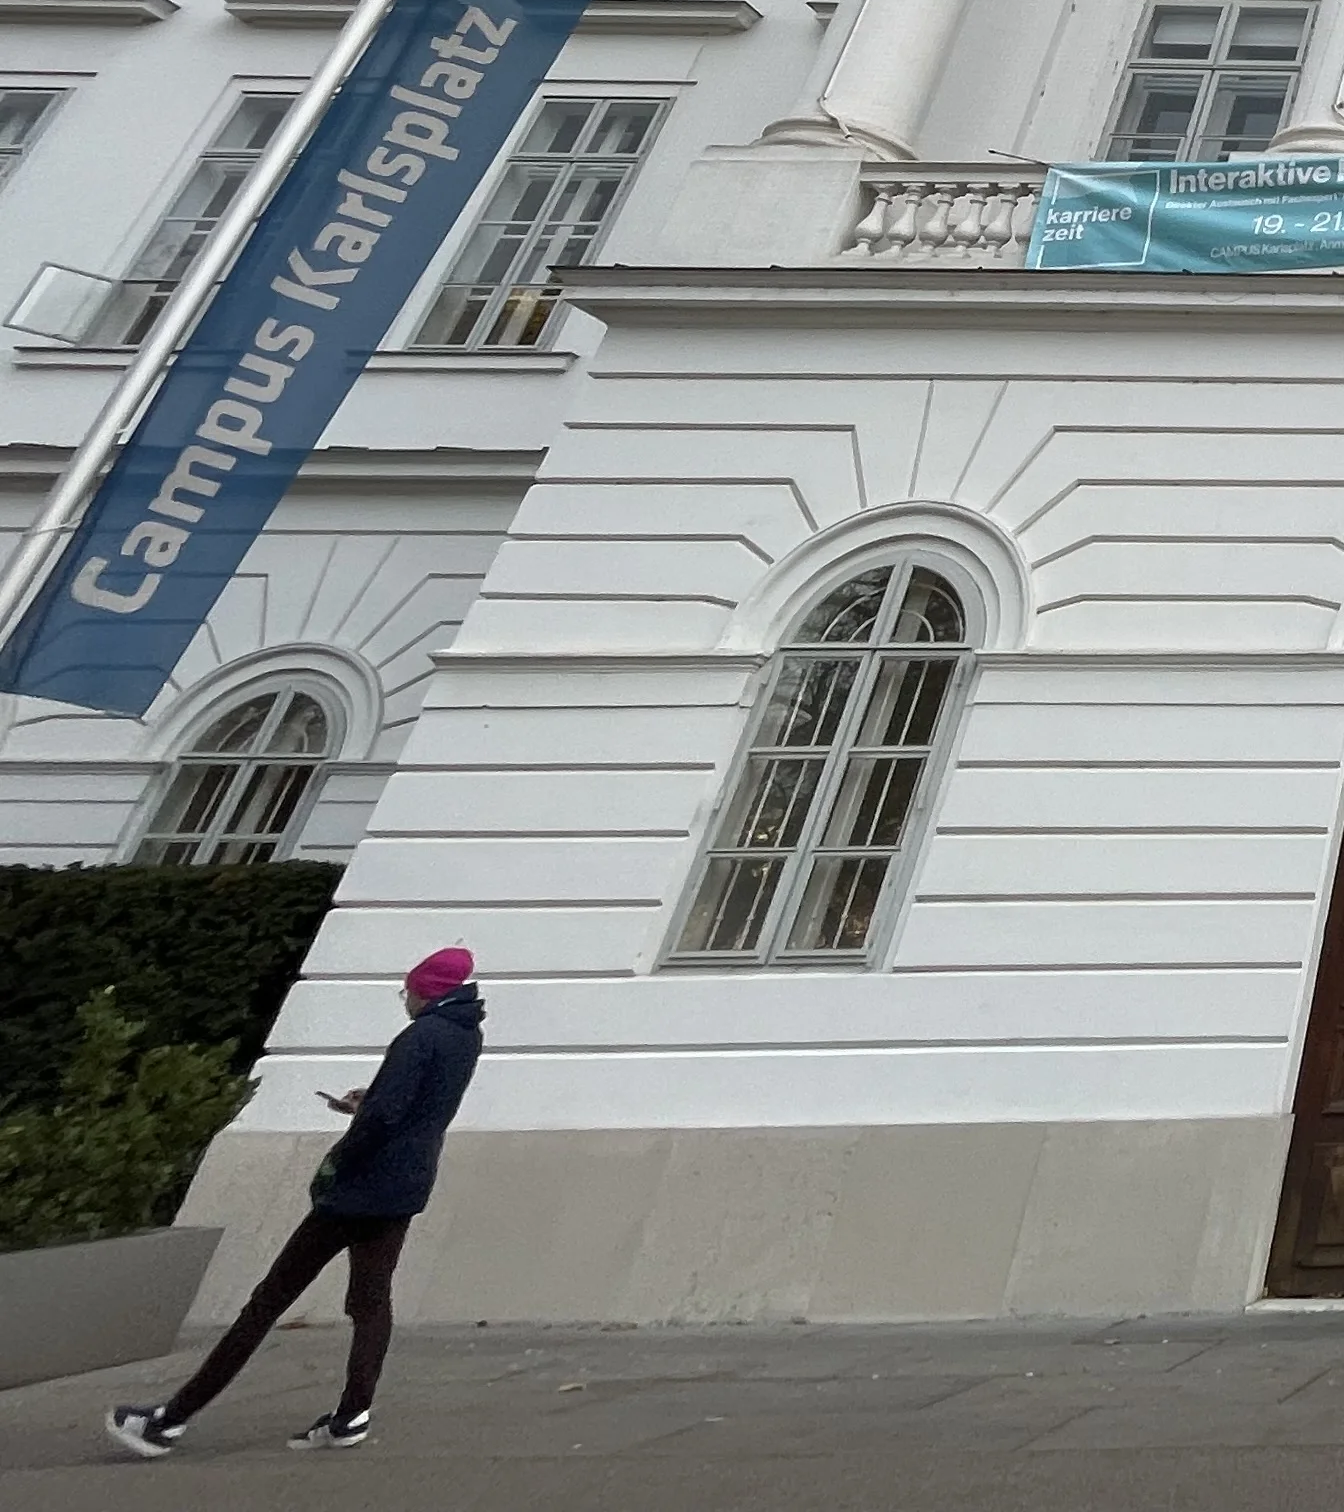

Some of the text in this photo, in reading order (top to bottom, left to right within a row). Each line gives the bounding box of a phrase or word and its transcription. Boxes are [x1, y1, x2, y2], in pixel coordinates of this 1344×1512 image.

[1169, 161, 1332, 194] Interaktive
[1046, 206, 1132, 225] karriere
[1253, 214, 1285, 235] 19.
[1042, 224, 1085, 241] zeit
[71, 5, 520, 614] Campus Karlsplatz
